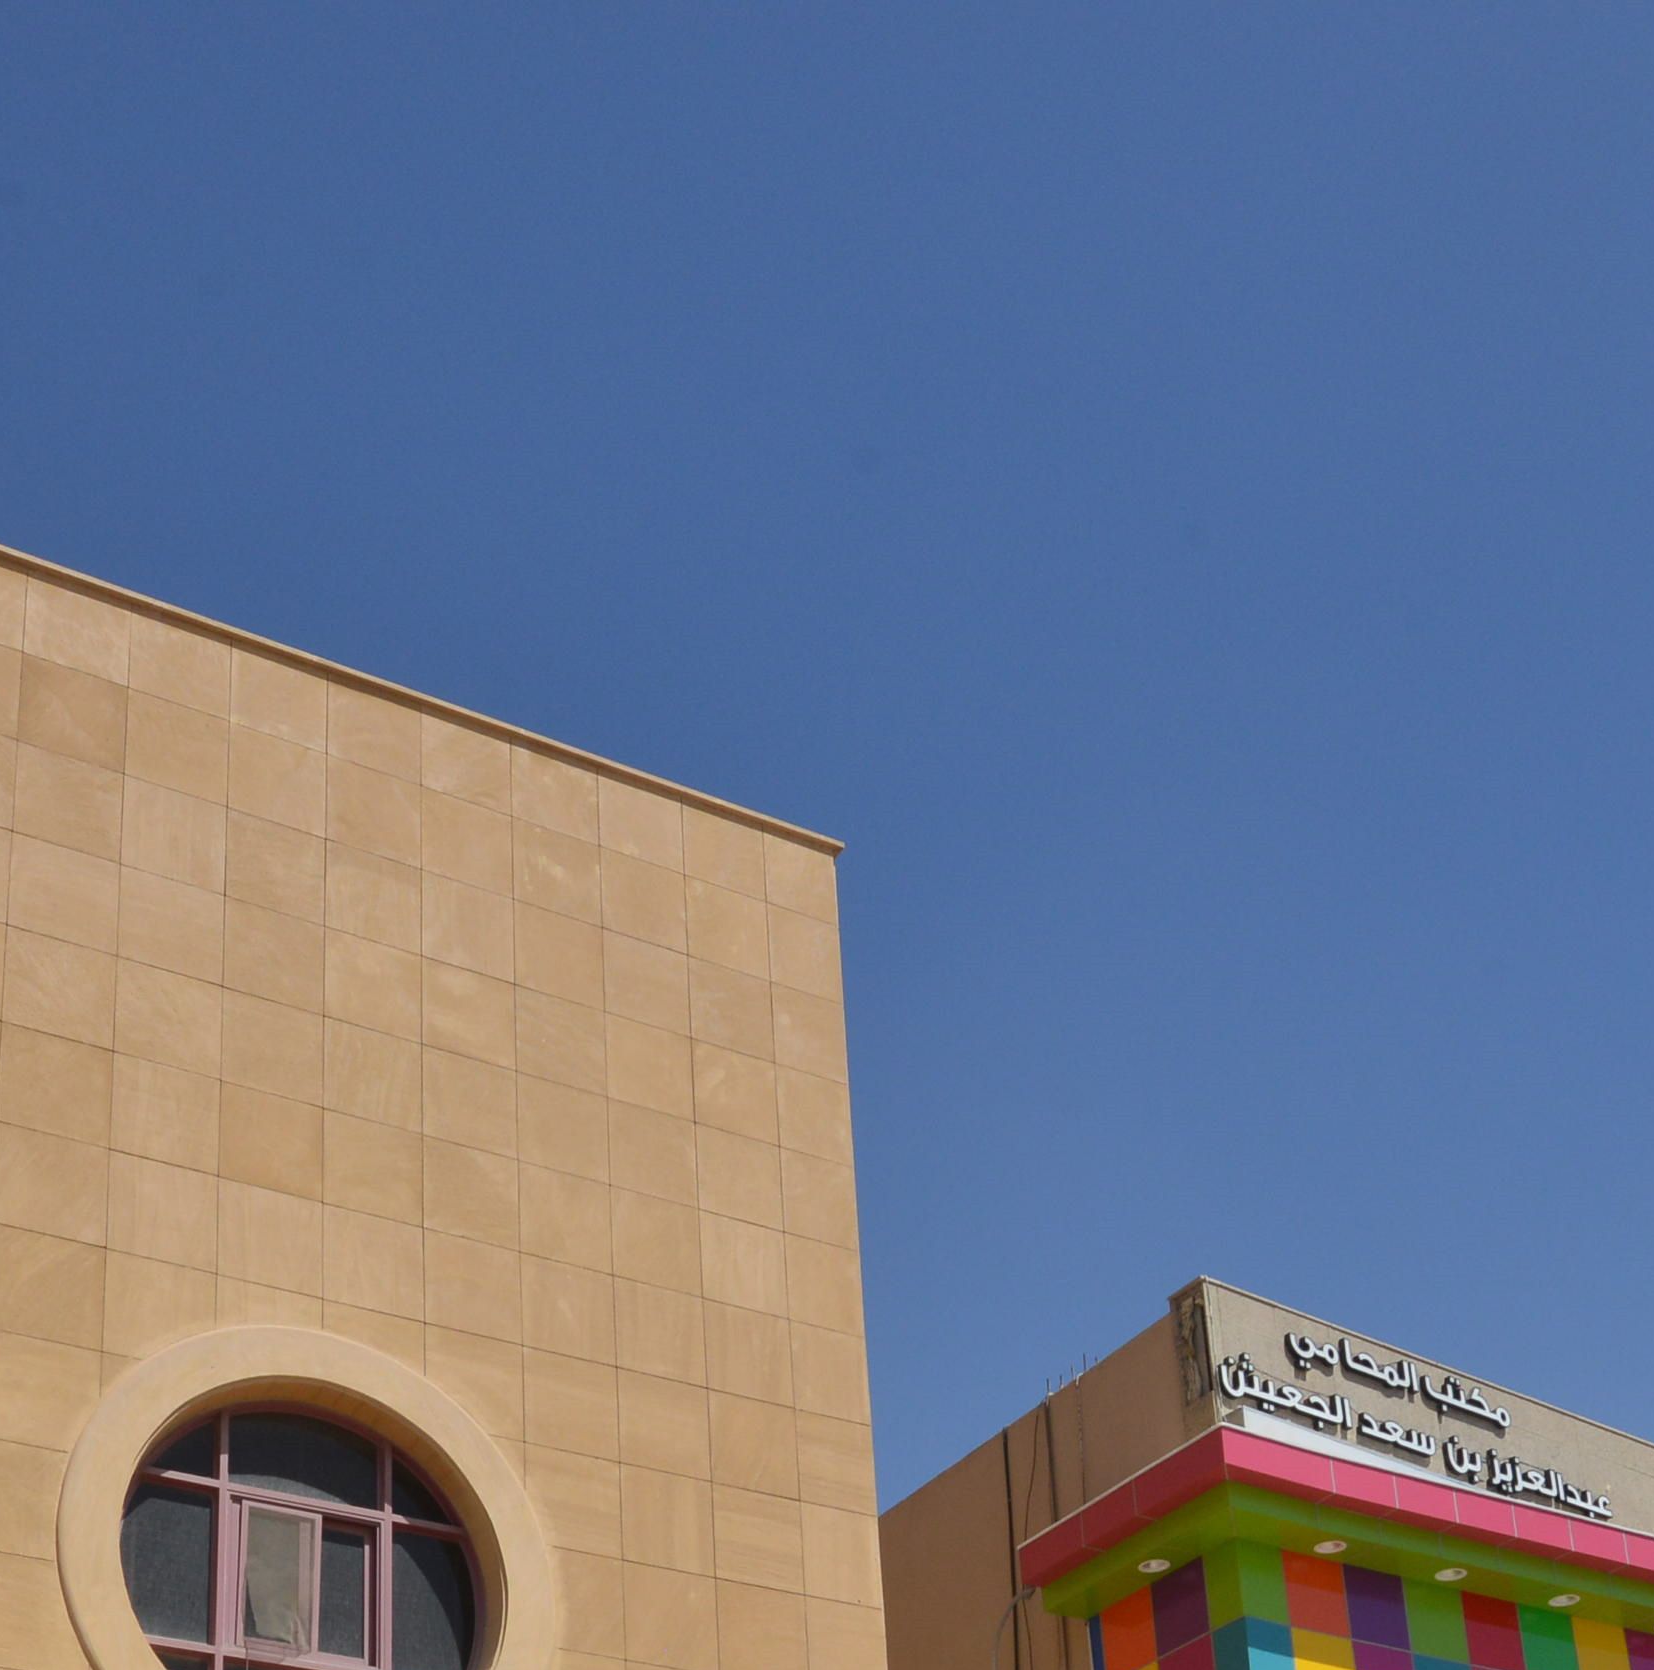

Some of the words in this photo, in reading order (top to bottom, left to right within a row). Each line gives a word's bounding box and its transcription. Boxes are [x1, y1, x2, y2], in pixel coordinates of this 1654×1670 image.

[1288, 1332, 1420, 1394] المحامي
[1423, 1375, 1512, 1428] مكتب
[1360, 1412, 1436, 1457] سعد
[1445, 1436, 1482, 1483] بن
[1489, 1449, 1613, 1519] عبدالعزيز
